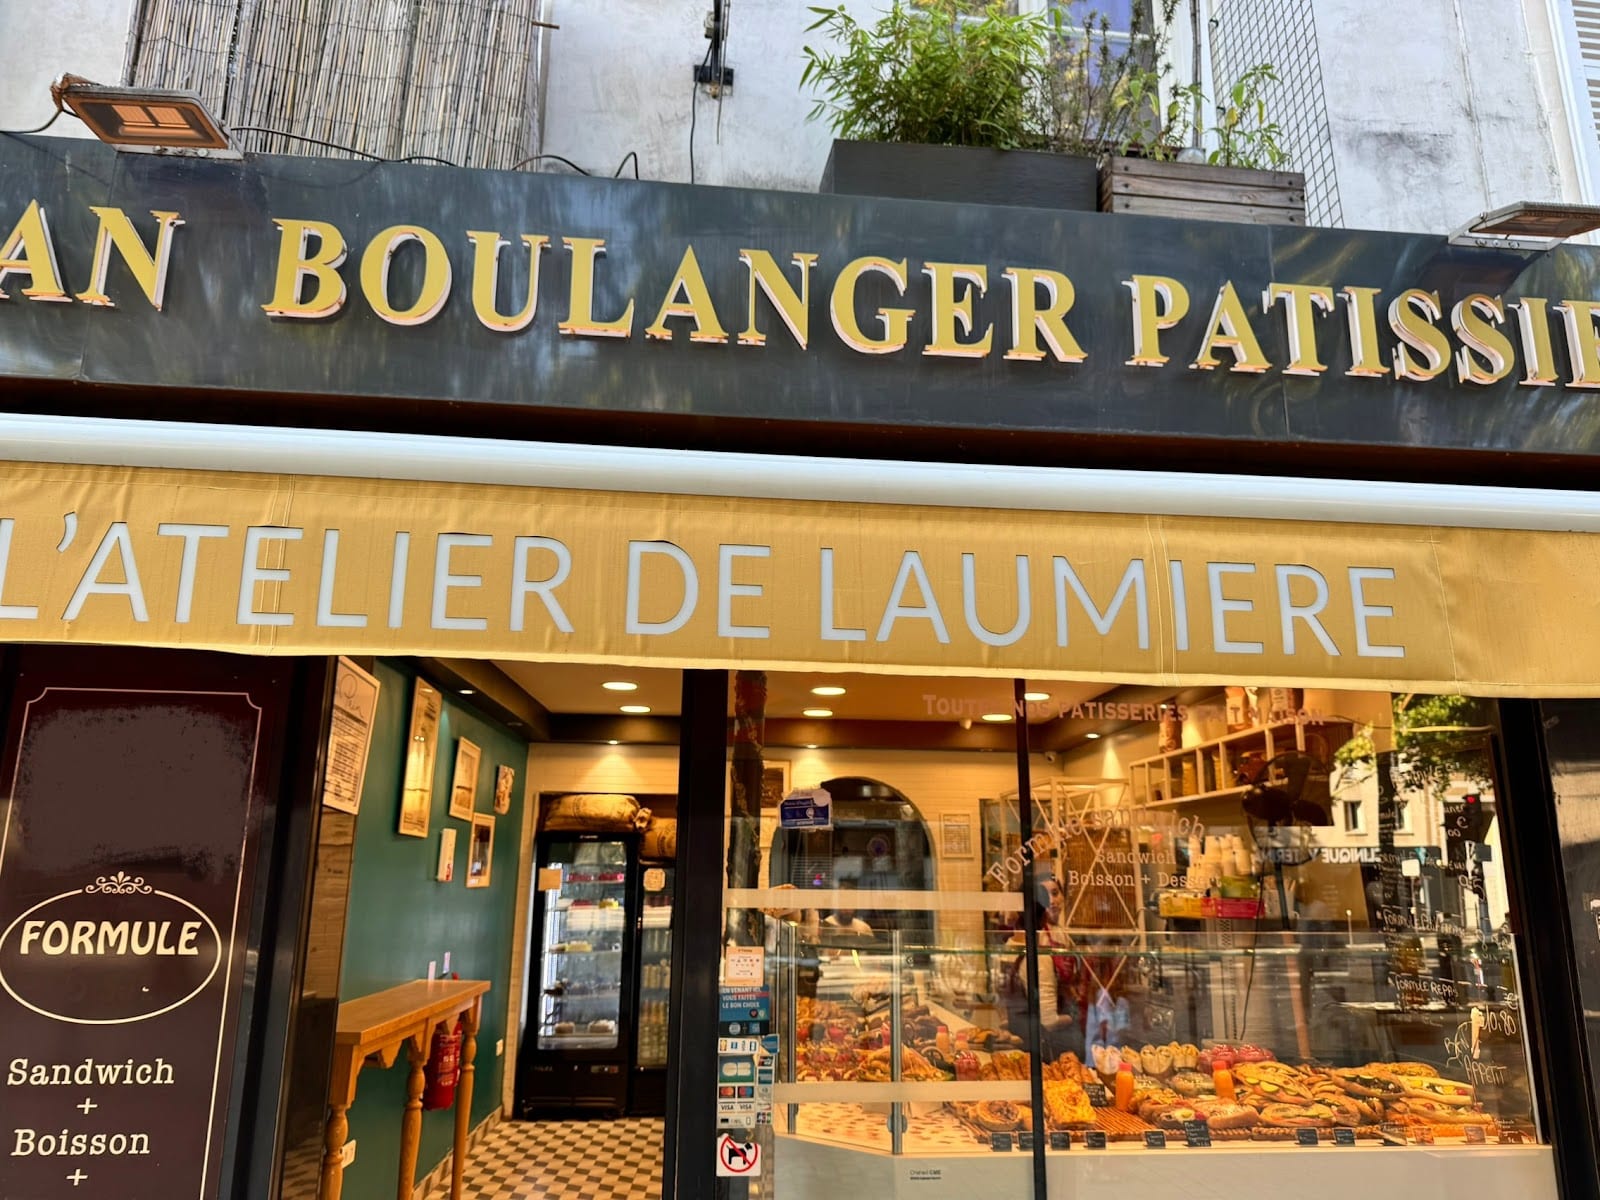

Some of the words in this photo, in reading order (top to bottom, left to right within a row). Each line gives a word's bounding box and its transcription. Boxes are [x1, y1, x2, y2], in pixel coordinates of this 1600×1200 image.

[261, 216, 1088, 364] BOULANGER
[1121, 274, 1600, 389] PATISSIE
[0, 509, 574, 634] L'ATELIER
[625, 539, 771, 640] DE
[819, 546, 1406, 659] LAUMIERE
[1058, 702, 1189, 721] PATISSERIES
[987, 816, 1083, 889] Formle
[1092, 803, 1205, 843] sandich
[1097, 846, 1177, 865] Sandwich
[1068, 870, 1136, 887] Boisson
[19, 920, 202, 956] FORMULE
[6, 1057, 176, 1087] Sandwich
[76, 1096, 98, 1116] +
[10, 1128, 151, 1157] Boisson
[66, 1167, 89, 1187] +
